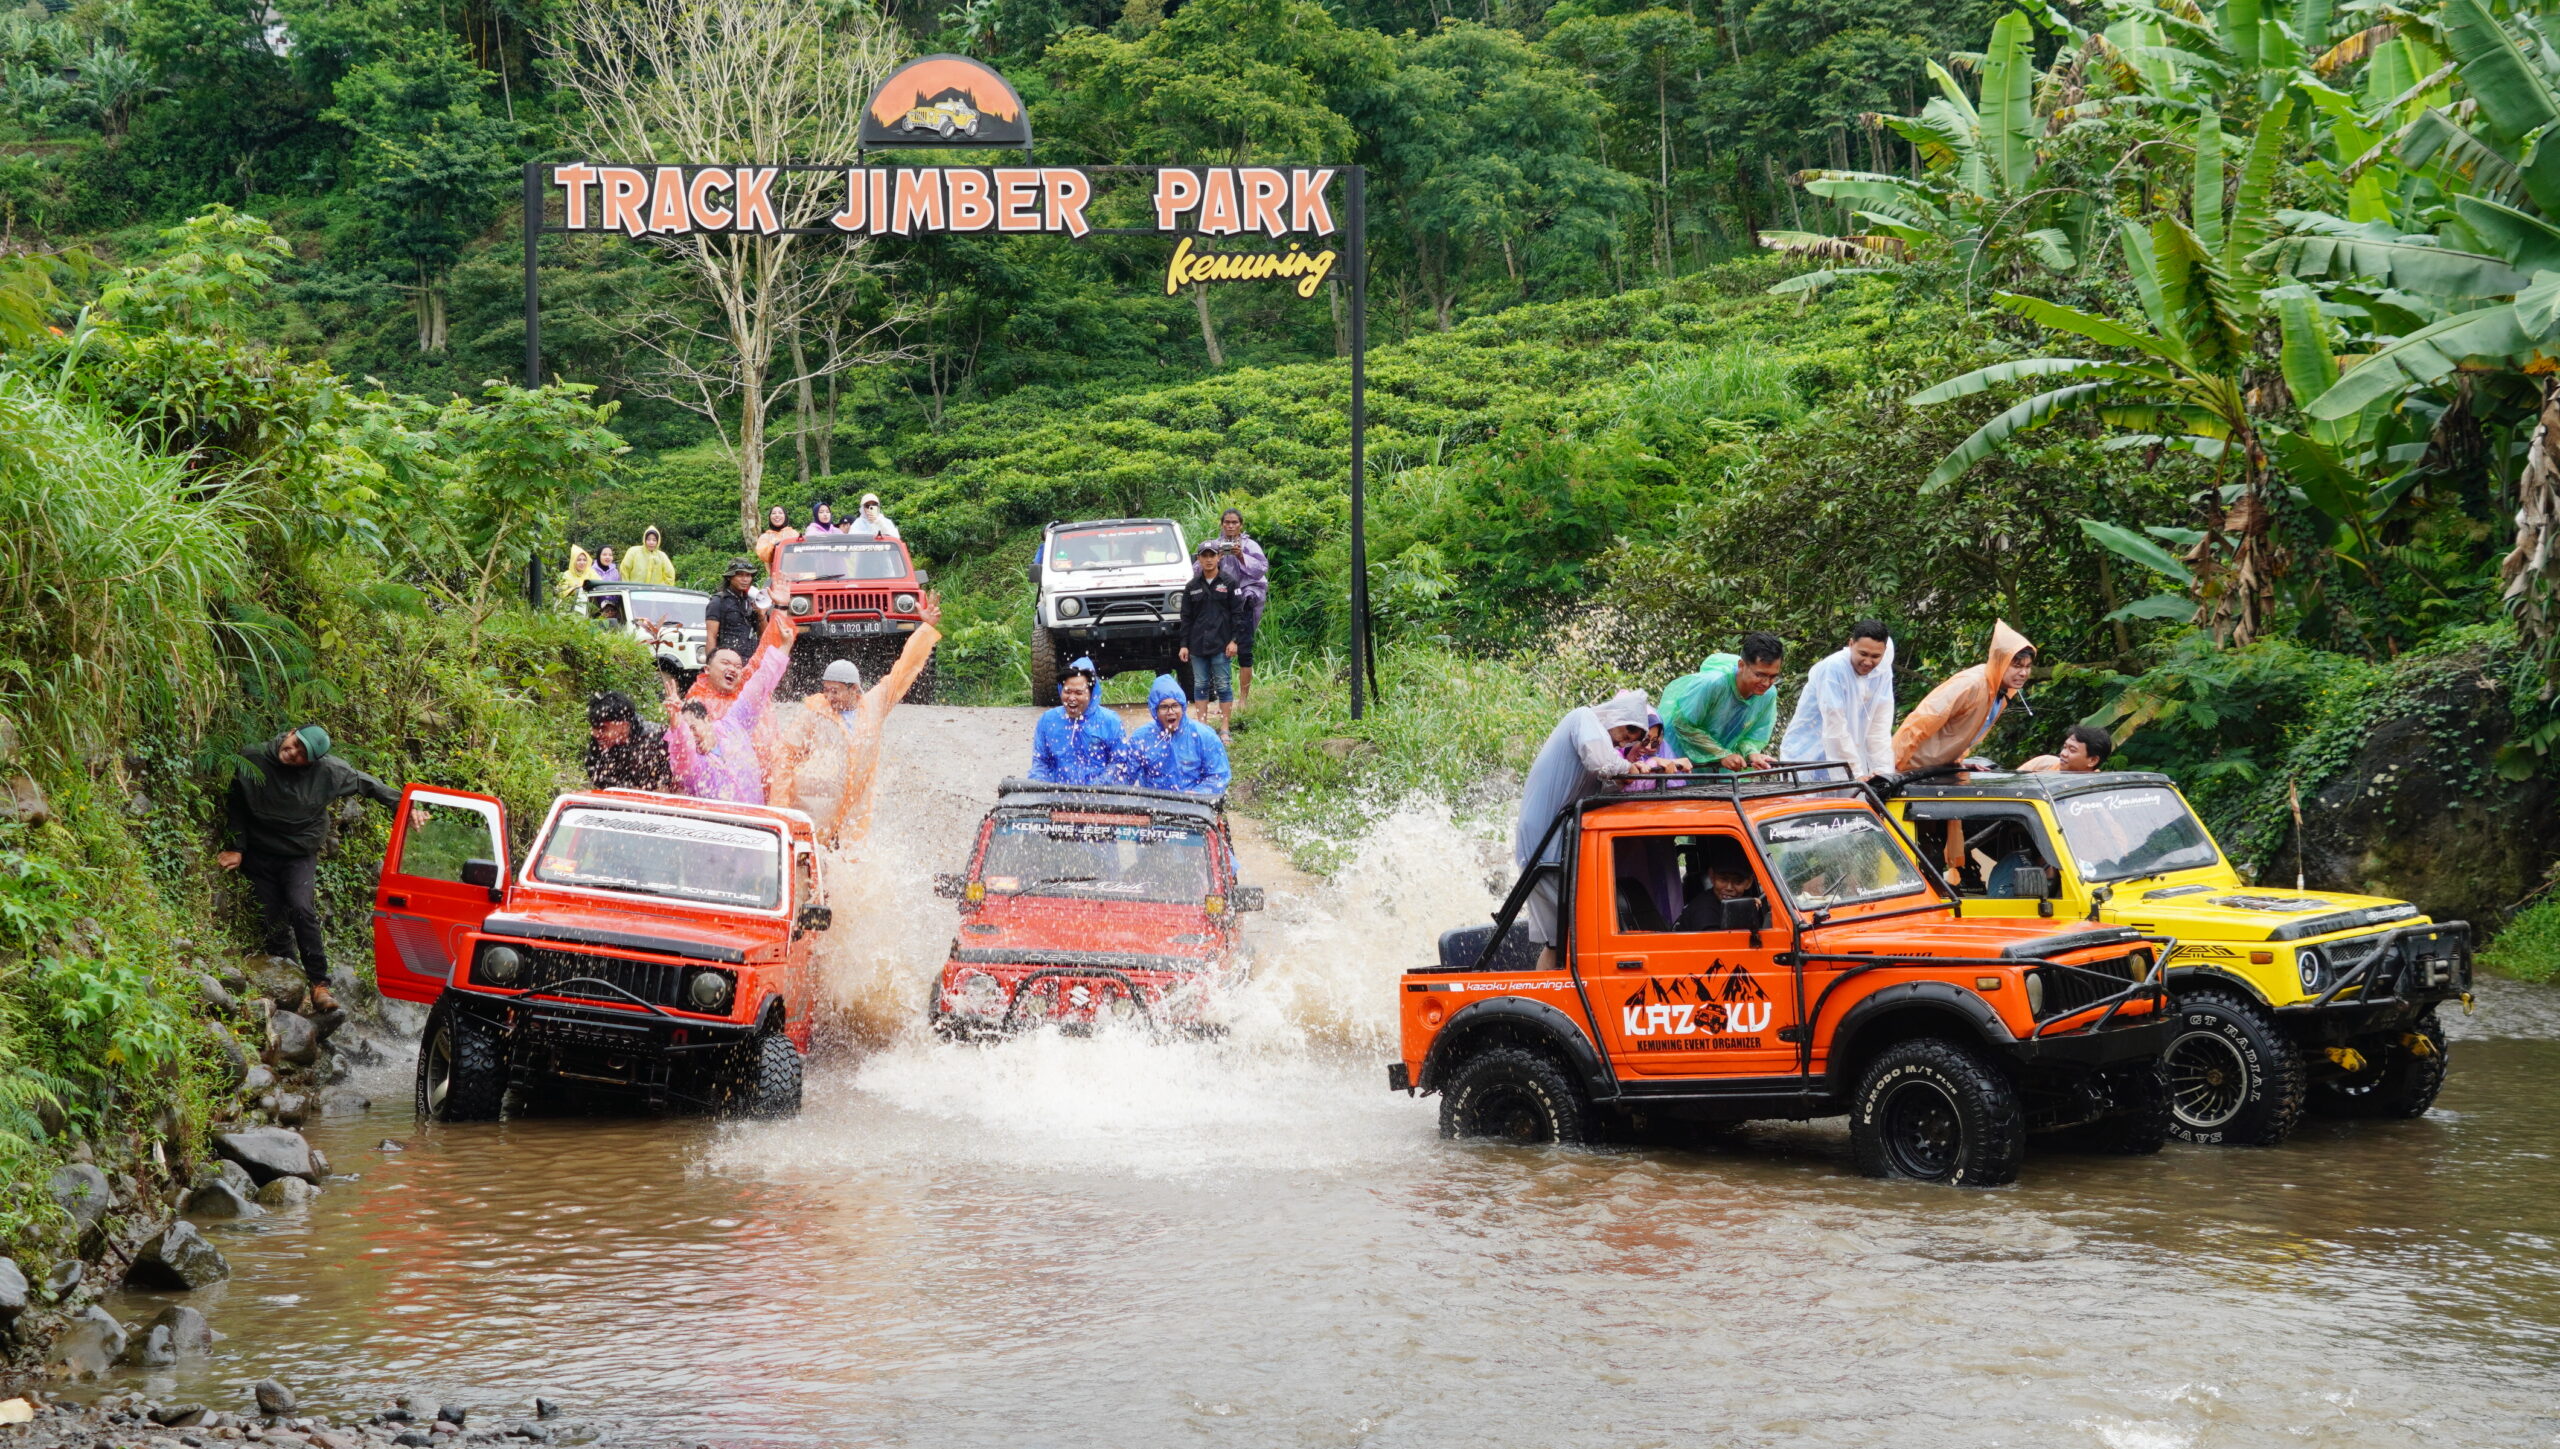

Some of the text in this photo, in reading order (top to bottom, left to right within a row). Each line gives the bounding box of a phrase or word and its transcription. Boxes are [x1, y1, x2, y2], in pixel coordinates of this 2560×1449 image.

[554, 161, 1336, 239] TRACK JIMBER PARK
[842, 623, 861, 633] 1020
[1011, 822, 1075, 834] KEMUNING
[1078, 825, 1110, 835] JEEP
[1113, 827, 1188, 840] ADVENTURE
[1029, 953, 1137, 964] OVERLANDING
[1466, 981, 1507, 991] kazoku
[1637, 1037, 1762, 1051] KEMUNING EVENT ORGANIZER
[2189, 1014, 2263, 1102] GT RADIAL
[1863, 1064, 1958, 1125] KOMODO M/T PLUS
